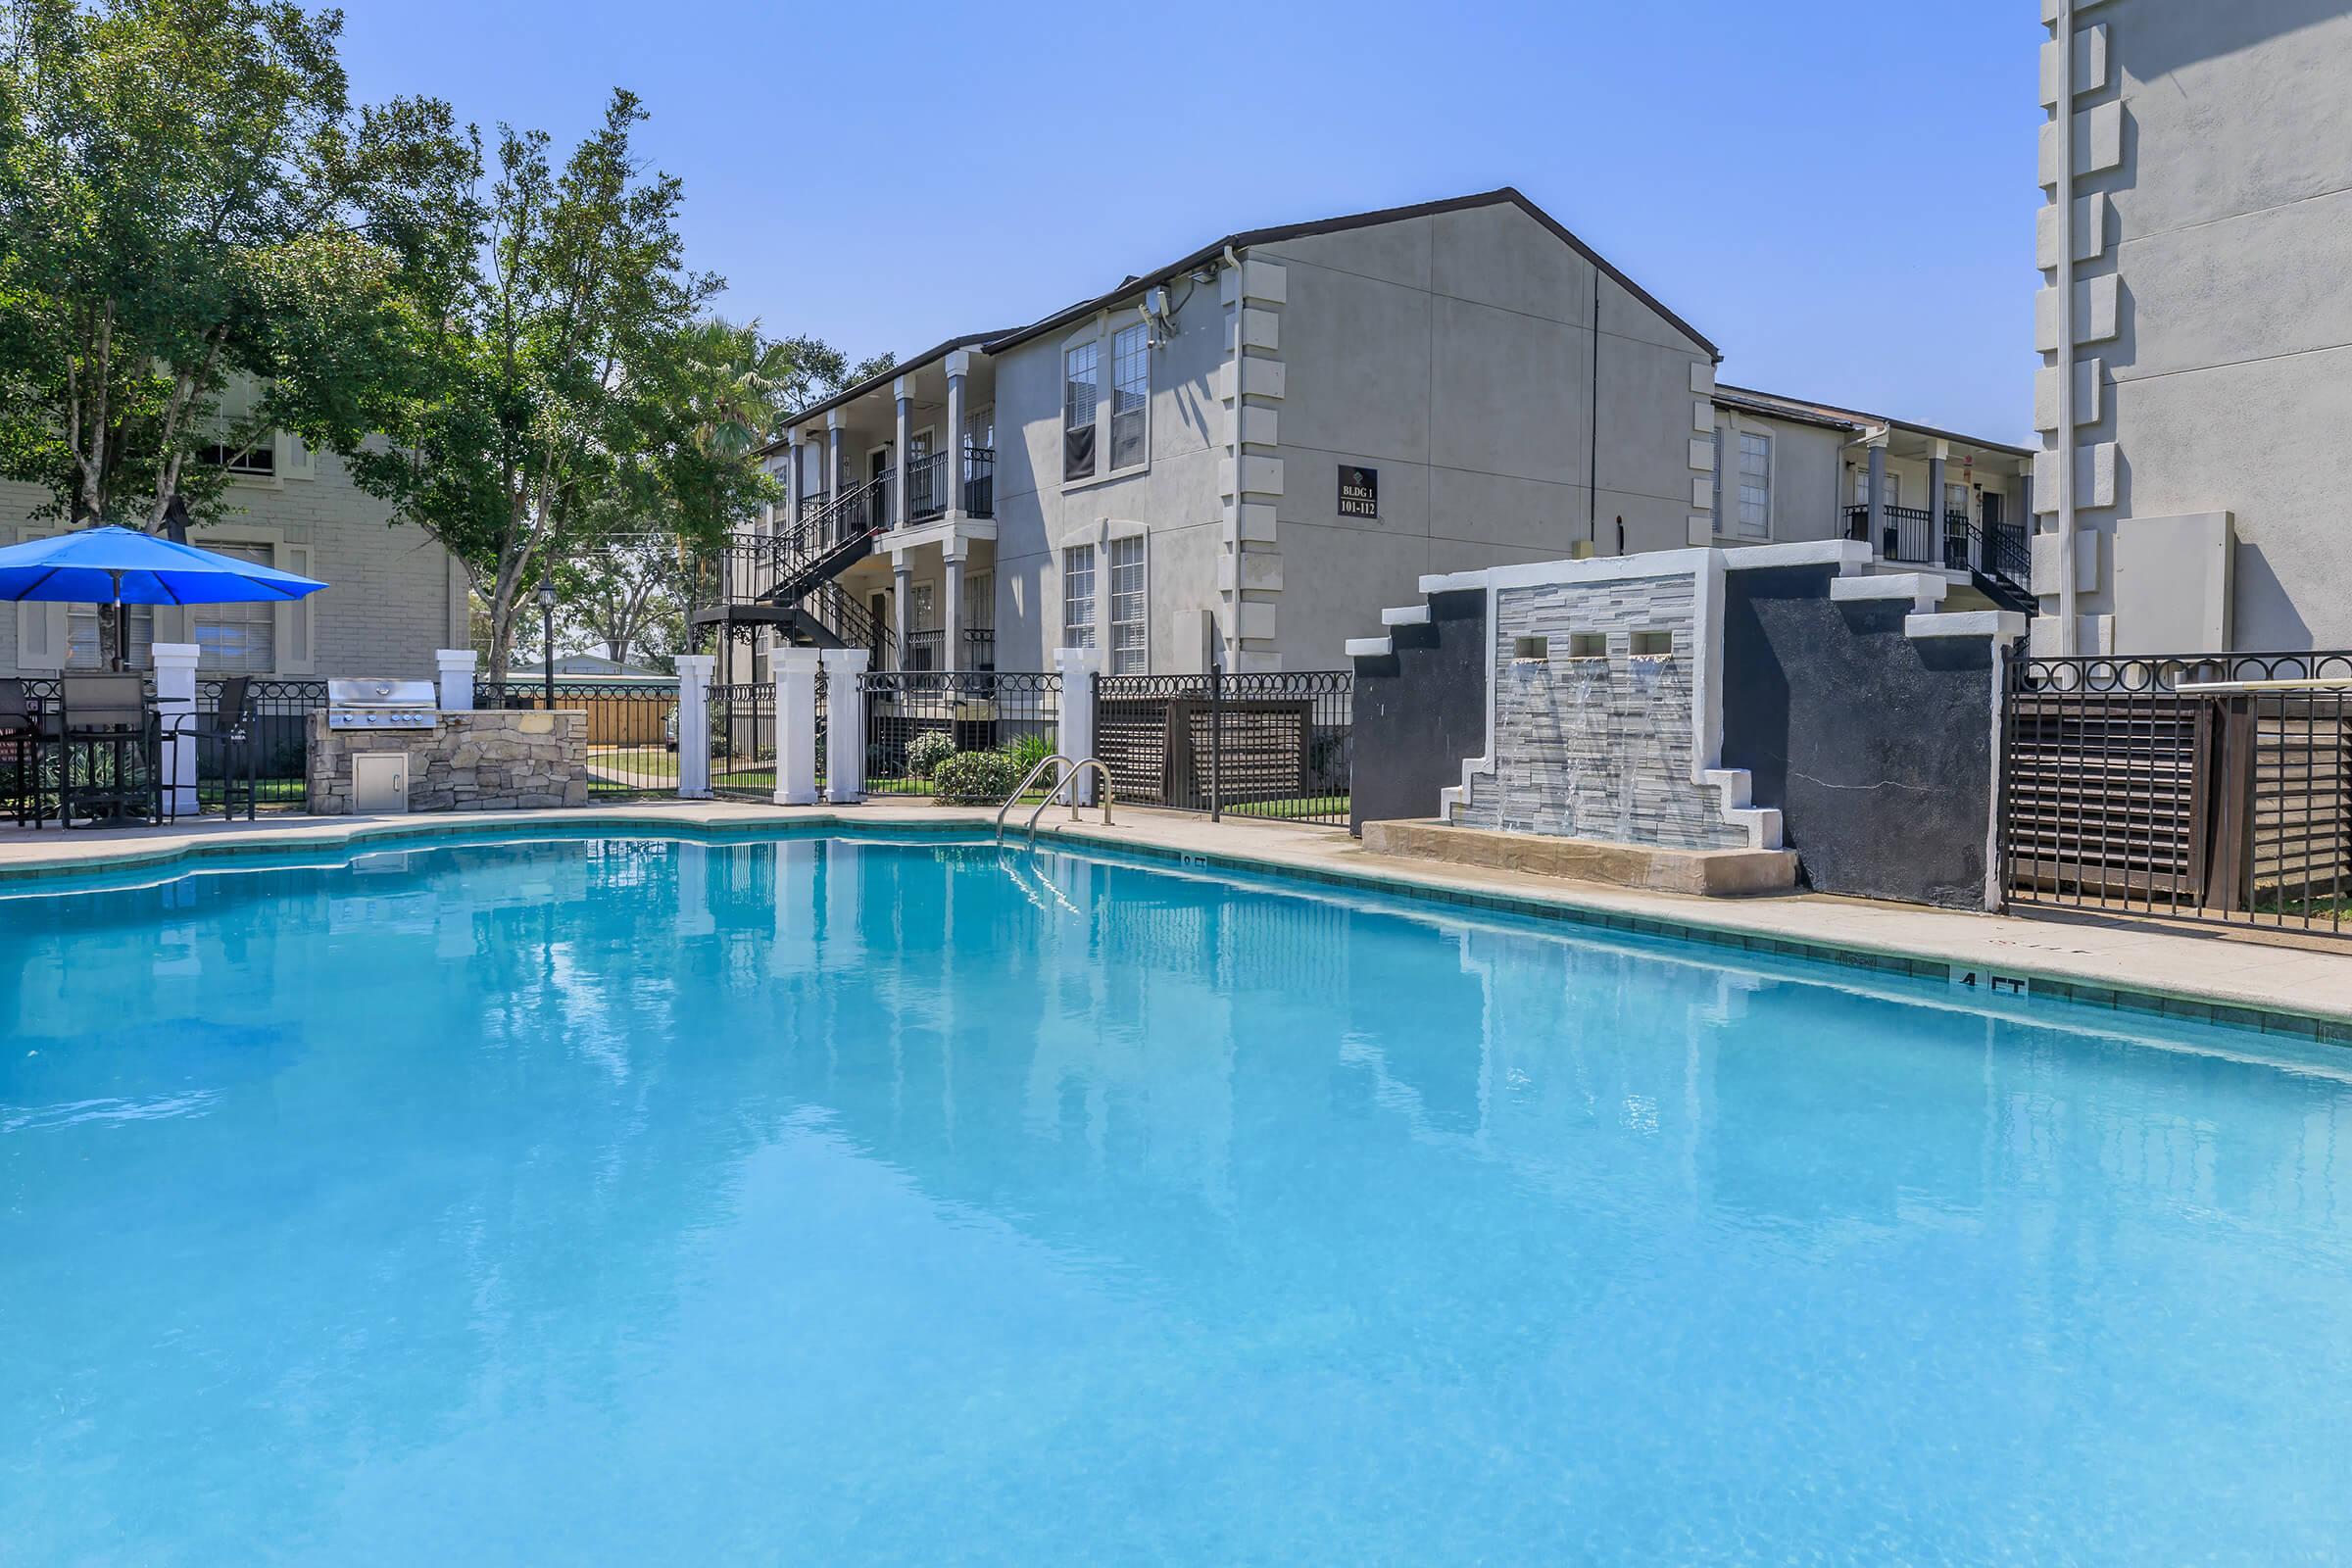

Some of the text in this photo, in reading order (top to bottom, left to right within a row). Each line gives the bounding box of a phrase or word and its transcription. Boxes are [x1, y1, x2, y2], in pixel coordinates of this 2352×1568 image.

[1343, 485, 1367, 498] BLDG
[1341, 500, 1375, 514] 101-112
[1991, 976, 2026, 994] FT
